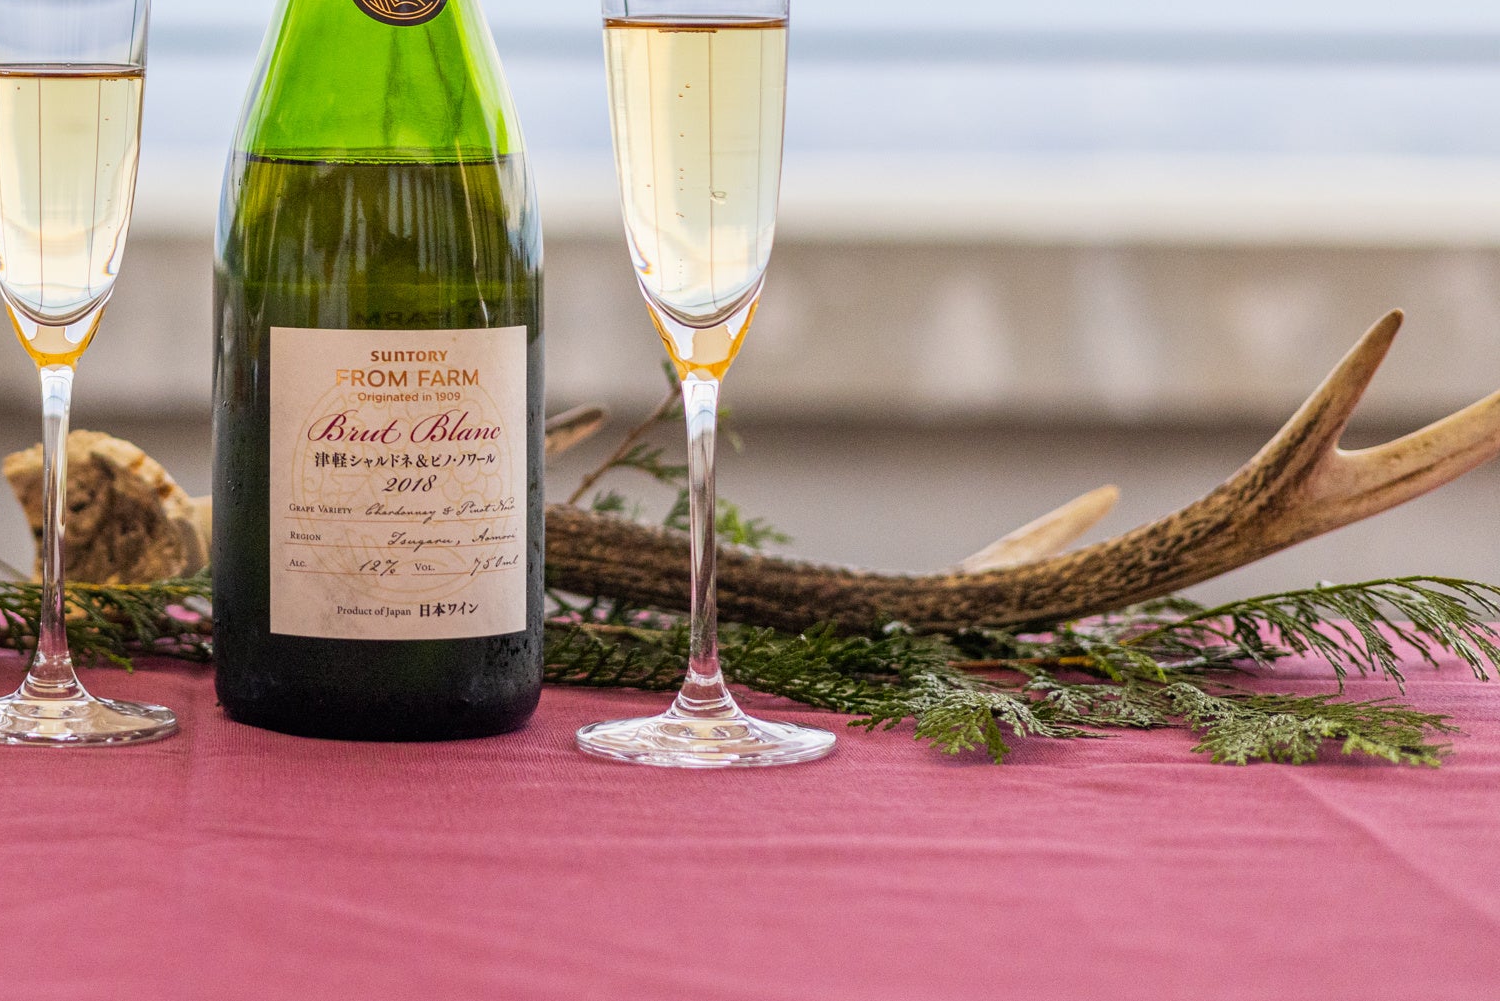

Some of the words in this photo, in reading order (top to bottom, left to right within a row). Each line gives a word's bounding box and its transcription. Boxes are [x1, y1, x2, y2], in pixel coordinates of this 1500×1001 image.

[370, 350, 448, 362] SUNTORY
[336, 369, 408, 387] FROM
[418, 369, 480, 387] FARM
[357, 392, 418, 403] Originated
[423, 392, 432, 402] in
[435, 392, 461, 401] 1909
[307, 409, 402, 444] Brut
[411, 409, 502, 443] Blanc
[381, 475, 437, 492] 2018
[365, 502, 436, 524] Chardonnay
[456, 501, 491, 517] Pinot
[471, 528, 517, 543] Aomori
[359, 559, 399, 576] 12%
[337, 606, 372, 616] Product
[374, 606, 385, 616] of
[385, 606, 412, 618] Japan
[419, 602, 480, 617] 日本ワイン
